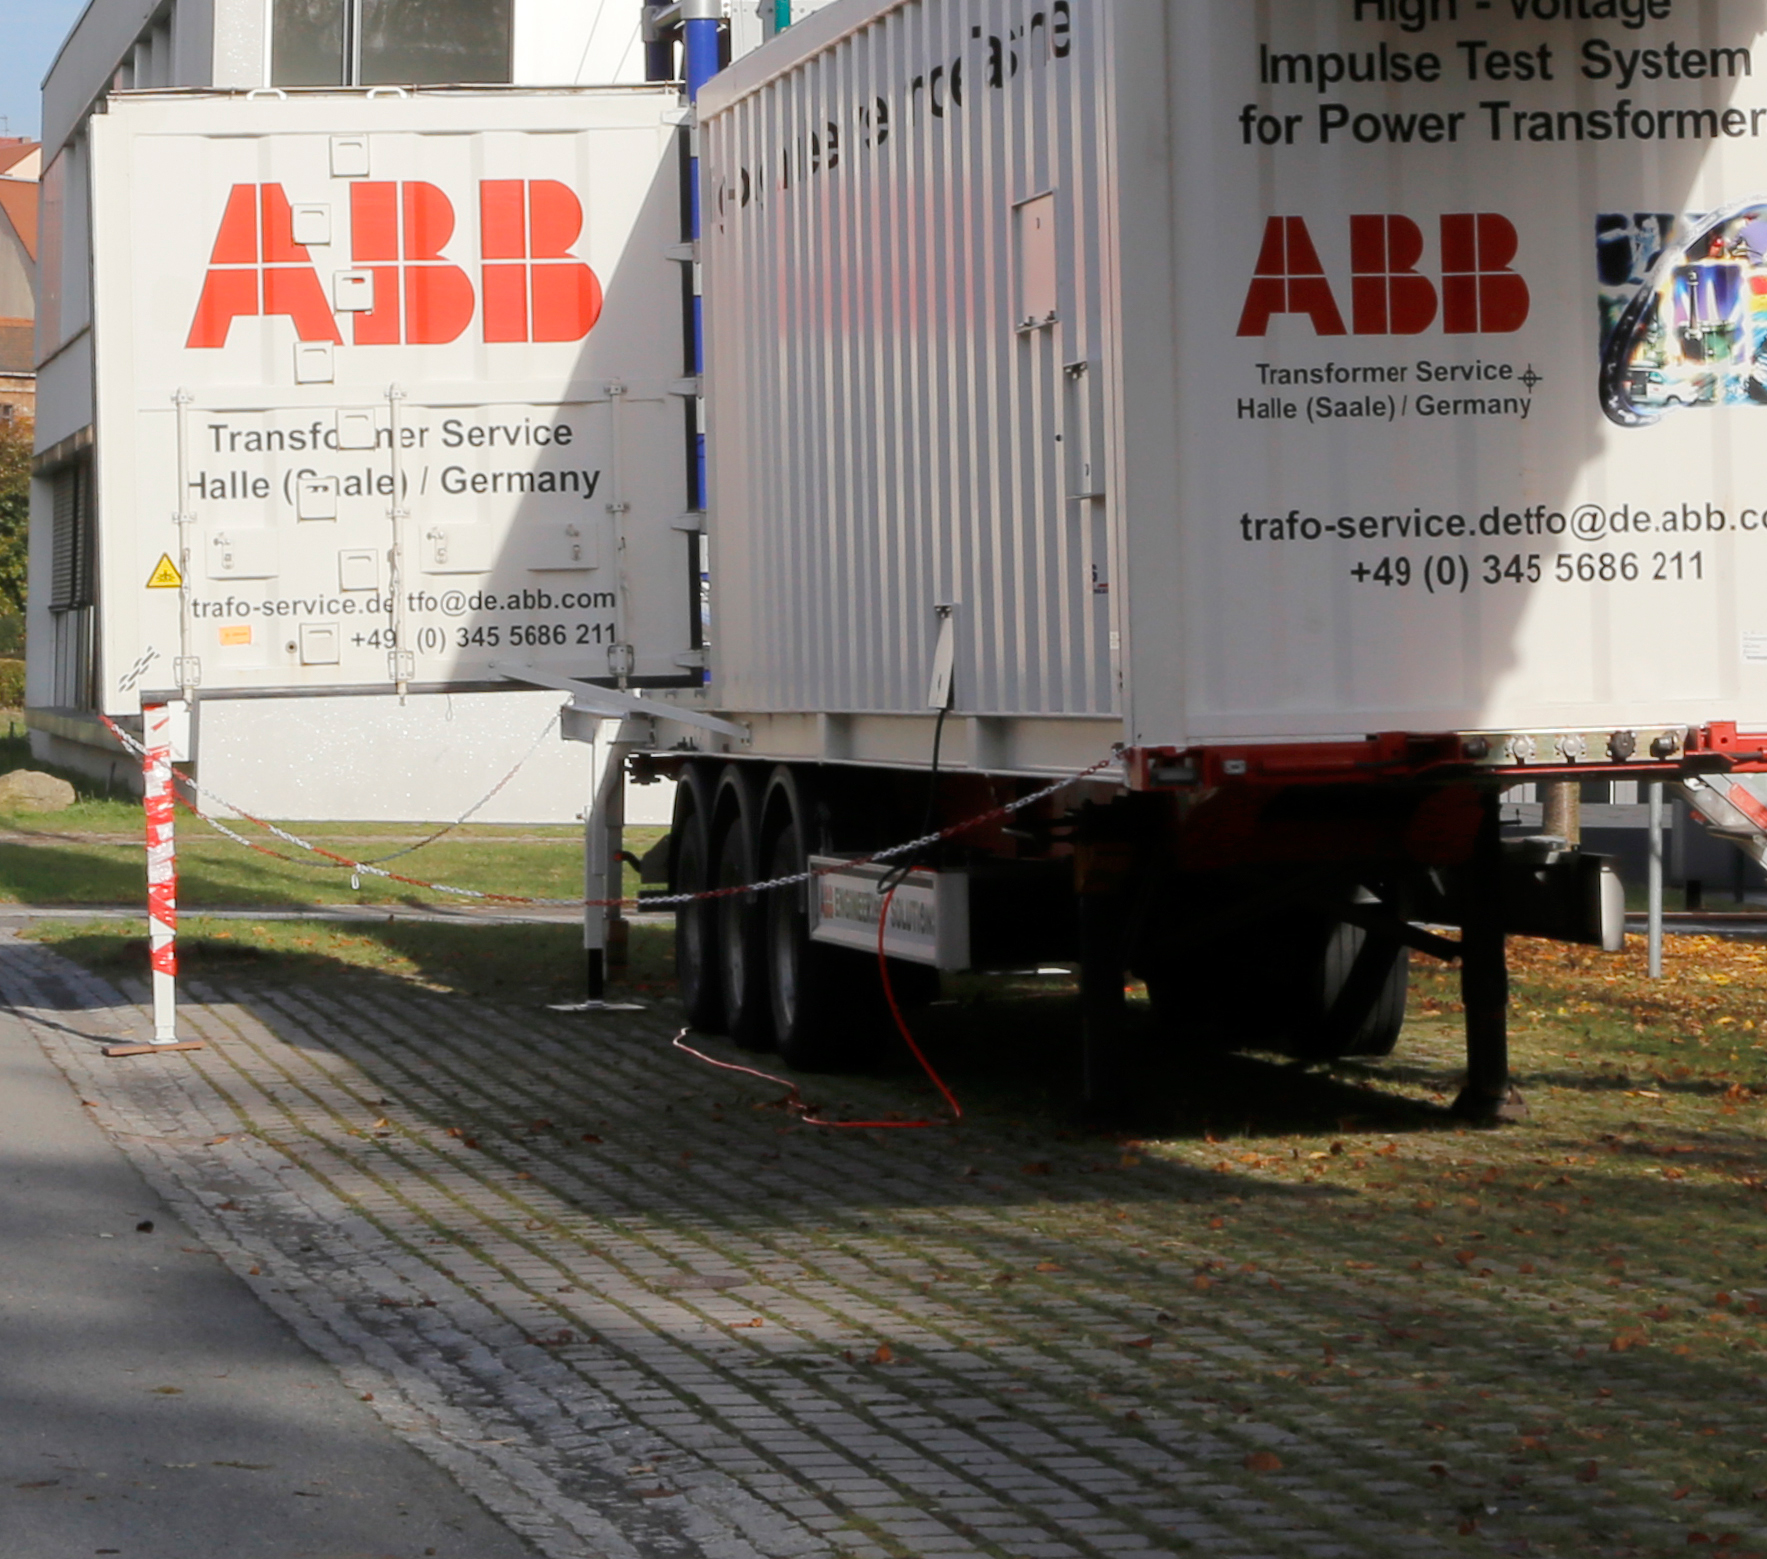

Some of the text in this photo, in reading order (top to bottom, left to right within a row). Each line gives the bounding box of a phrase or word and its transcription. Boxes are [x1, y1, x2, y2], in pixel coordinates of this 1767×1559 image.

[1259, 38, 1752, 94] Impulse Test System
[1238, 103, 1303, 145] for
[1319, 102, 1466, 144] Power
[185, 179, 603, 349] ABB
[1235, 212, 1531, 337] ABB
[1255, 360, 1514, 385] Transformer Service
[1237, 397, 1298, 420] Halle
[1306, 394, 1396, 424] (Saale)
[1416, 394, 1531, 420] Germany
[441, 418, 573, 449] Service
[441, 465, 602, 500] Germany
[1350, 550, 1705, 594] +49 (0) 345 5686 211
[351, 623, 617, 654] +49 (0) 345 5686 211
